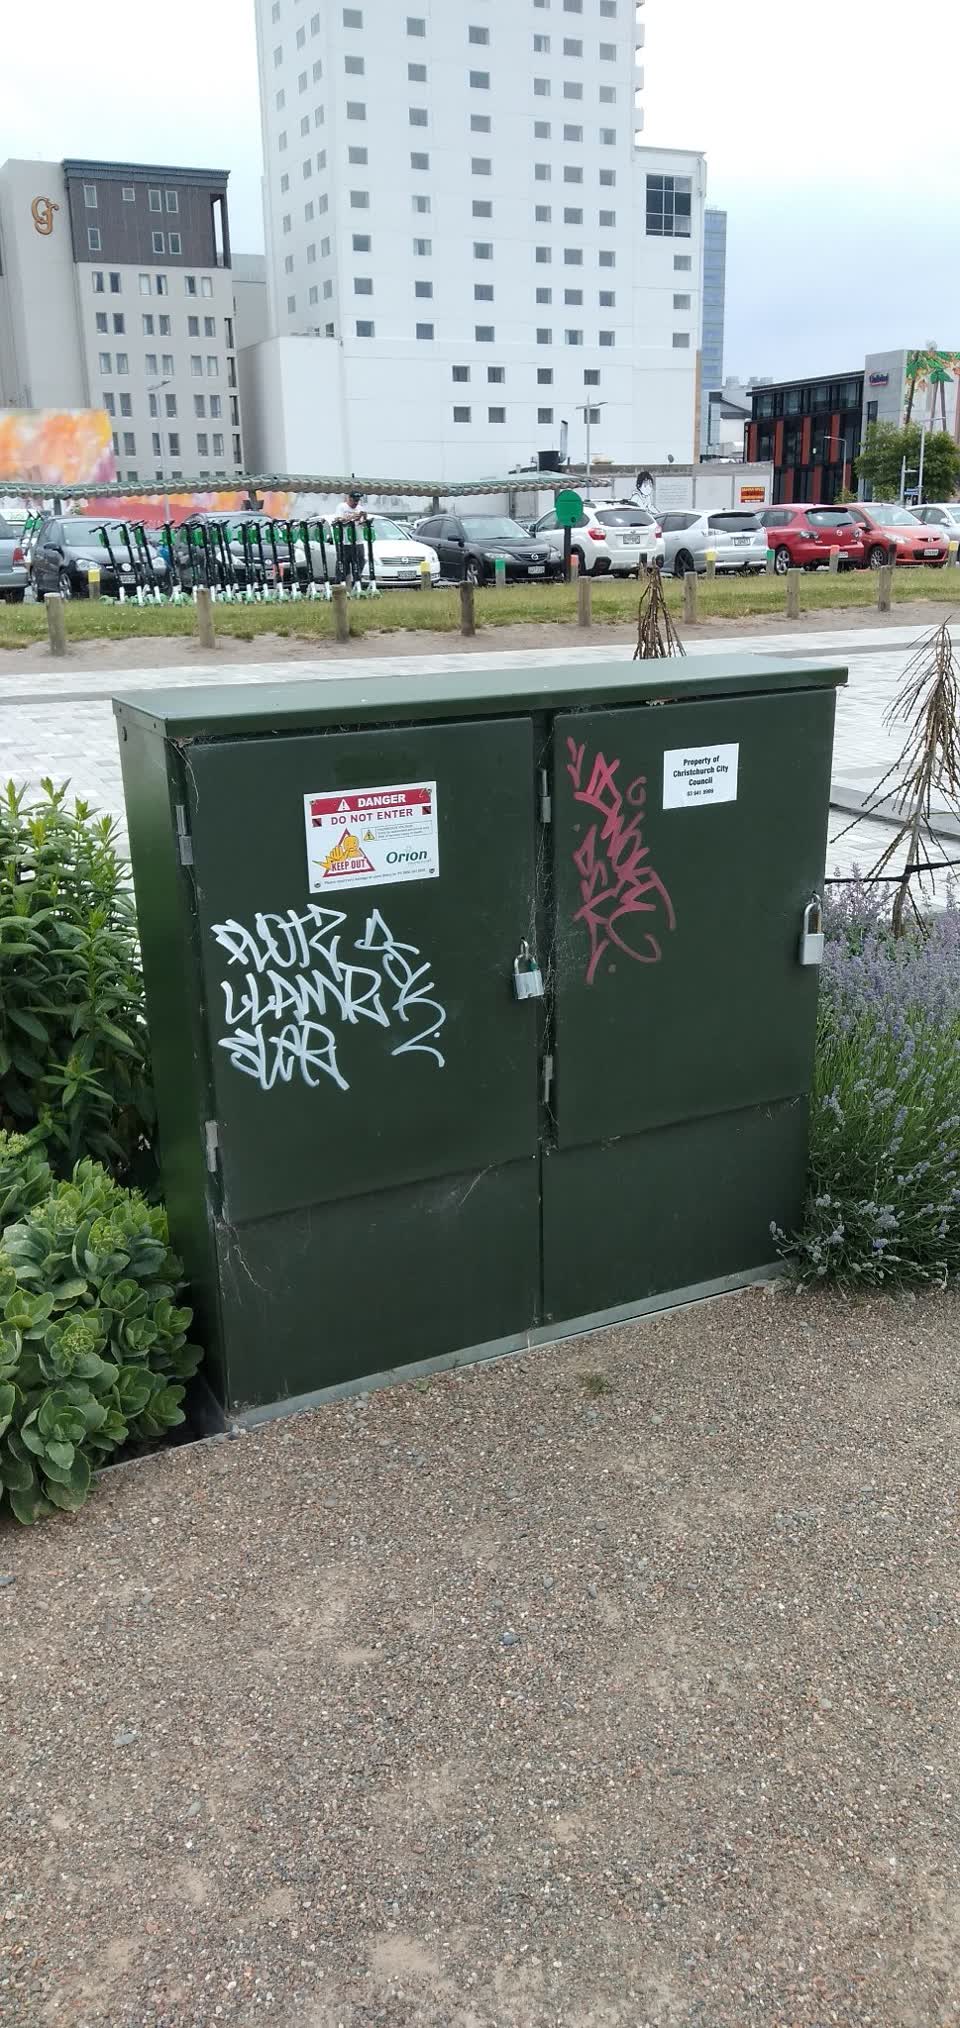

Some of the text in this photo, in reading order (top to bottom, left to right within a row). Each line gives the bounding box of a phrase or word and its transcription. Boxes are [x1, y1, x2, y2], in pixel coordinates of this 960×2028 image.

[683, 755, 720, 767] Property of
[673, 765, 729, 778] Christchurch City
[688, 777, 713, 786] Council
[357, 793, 407, 808] DANGER
[331, 808, 413, 826] DO NOT ENTER
[386, 850, 428, 864] Orion
[331, 859, 366, 872] KEEP OUT
